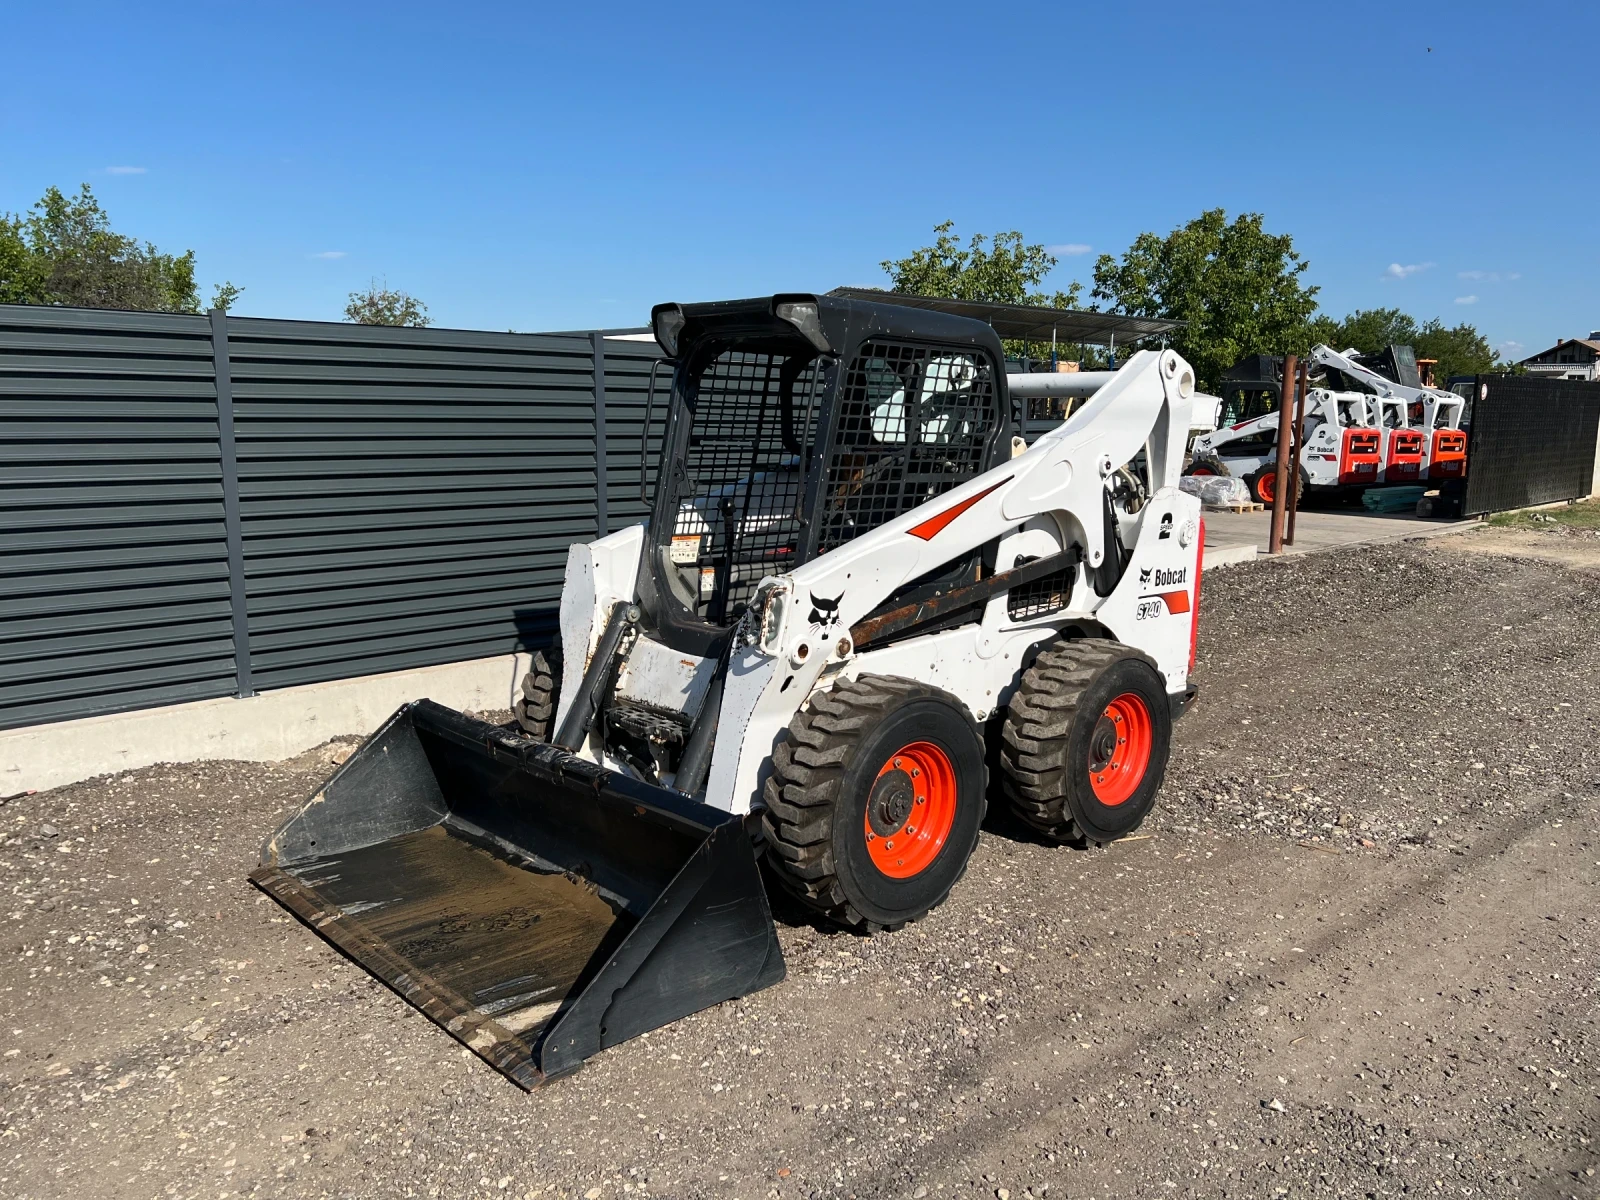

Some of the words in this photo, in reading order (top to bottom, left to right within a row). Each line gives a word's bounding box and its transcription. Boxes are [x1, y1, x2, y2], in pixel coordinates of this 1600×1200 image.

[1158, 512, 1172, 539] 2
[1155, 566, 1186, 586] Bobcat
[1136, 600, 1161, 620] S740
